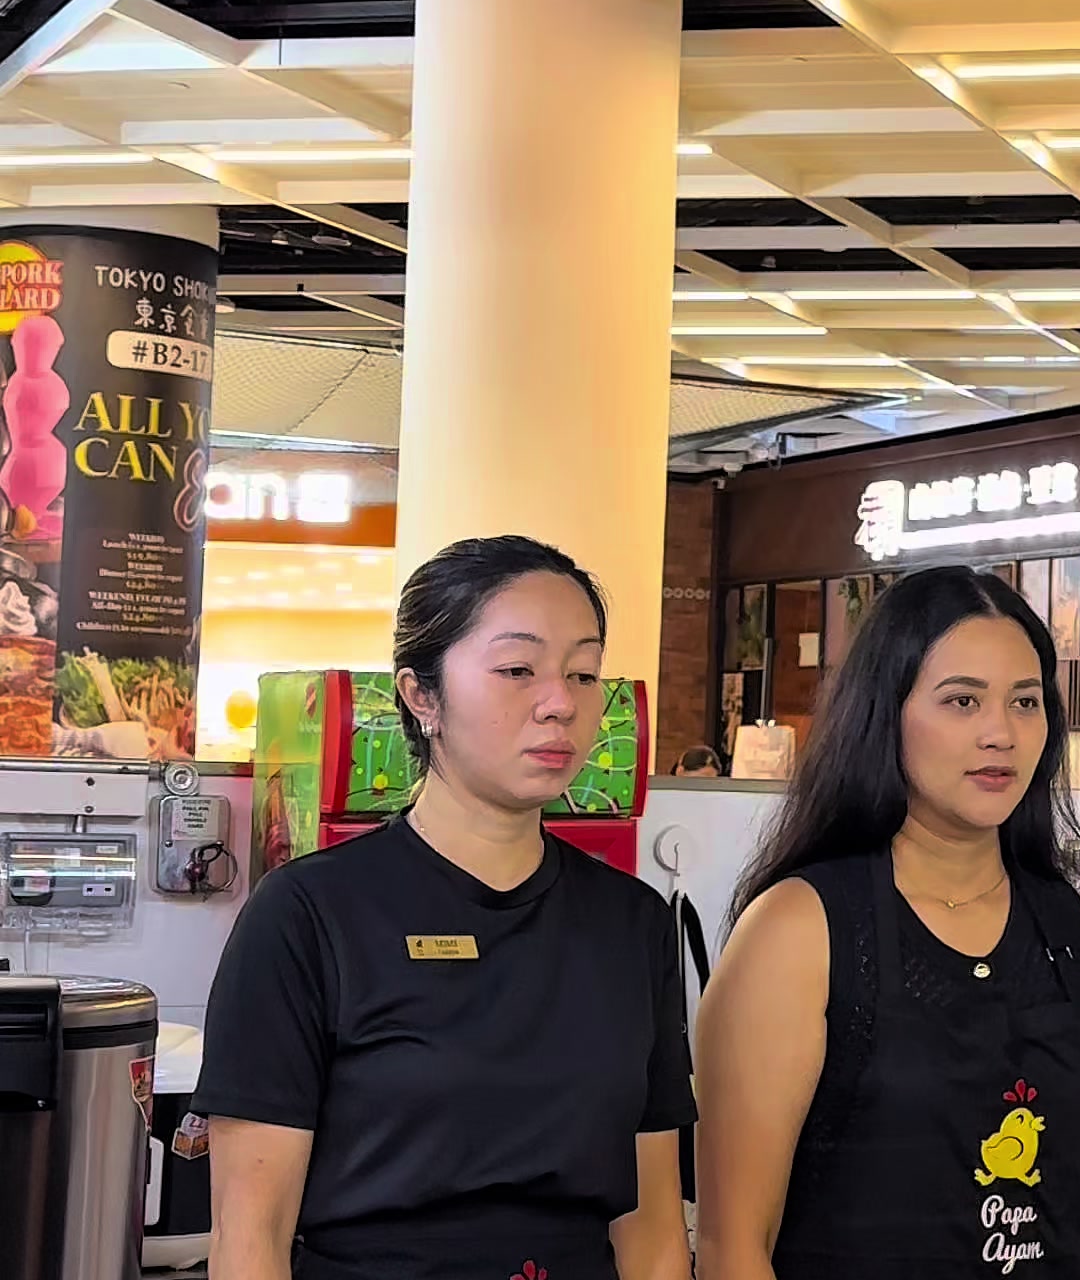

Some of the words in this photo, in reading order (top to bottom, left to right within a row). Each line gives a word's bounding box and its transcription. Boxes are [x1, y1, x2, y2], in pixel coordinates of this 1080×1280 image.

[0, 260, 63, 285] PORK
[95, 266, 166, 293] TOKYO
[172, 275, 209, 300] SHOK
[0, 287, 61, 310] LARD
[132, 342, 208, 373] #B2-17
[73, 392, 171, 438] ALL
[74, 437, 177, 482] CAN
[981, 1194, 1037, 1235] Papa
[982, 1232, 1044, 1275] Ayam
